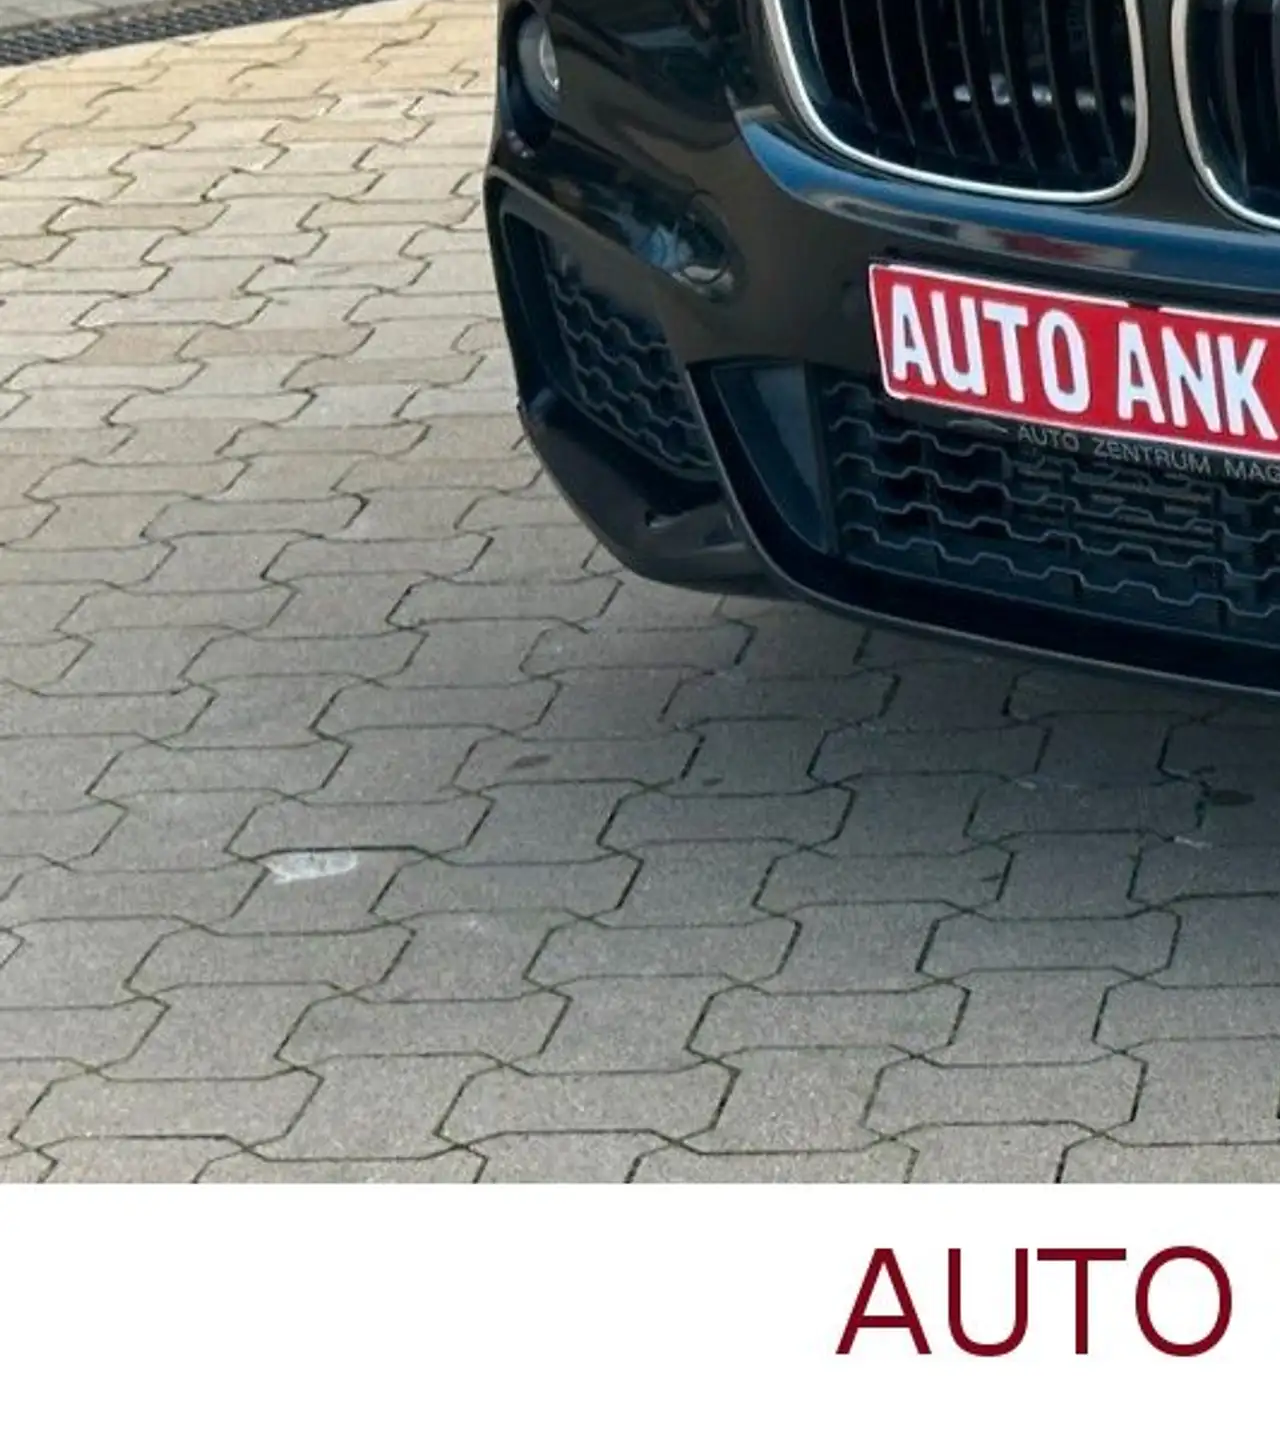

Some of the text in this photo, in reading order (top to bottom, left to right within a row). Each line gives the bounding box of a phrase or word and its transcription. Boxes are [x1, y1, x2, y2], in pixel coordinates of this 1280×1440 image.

[891, 283, 1091, 414] AUTO
[1016, 423, 1081, 455] AUTO
[1092, 437, 1212, 476] ZENTRUM
